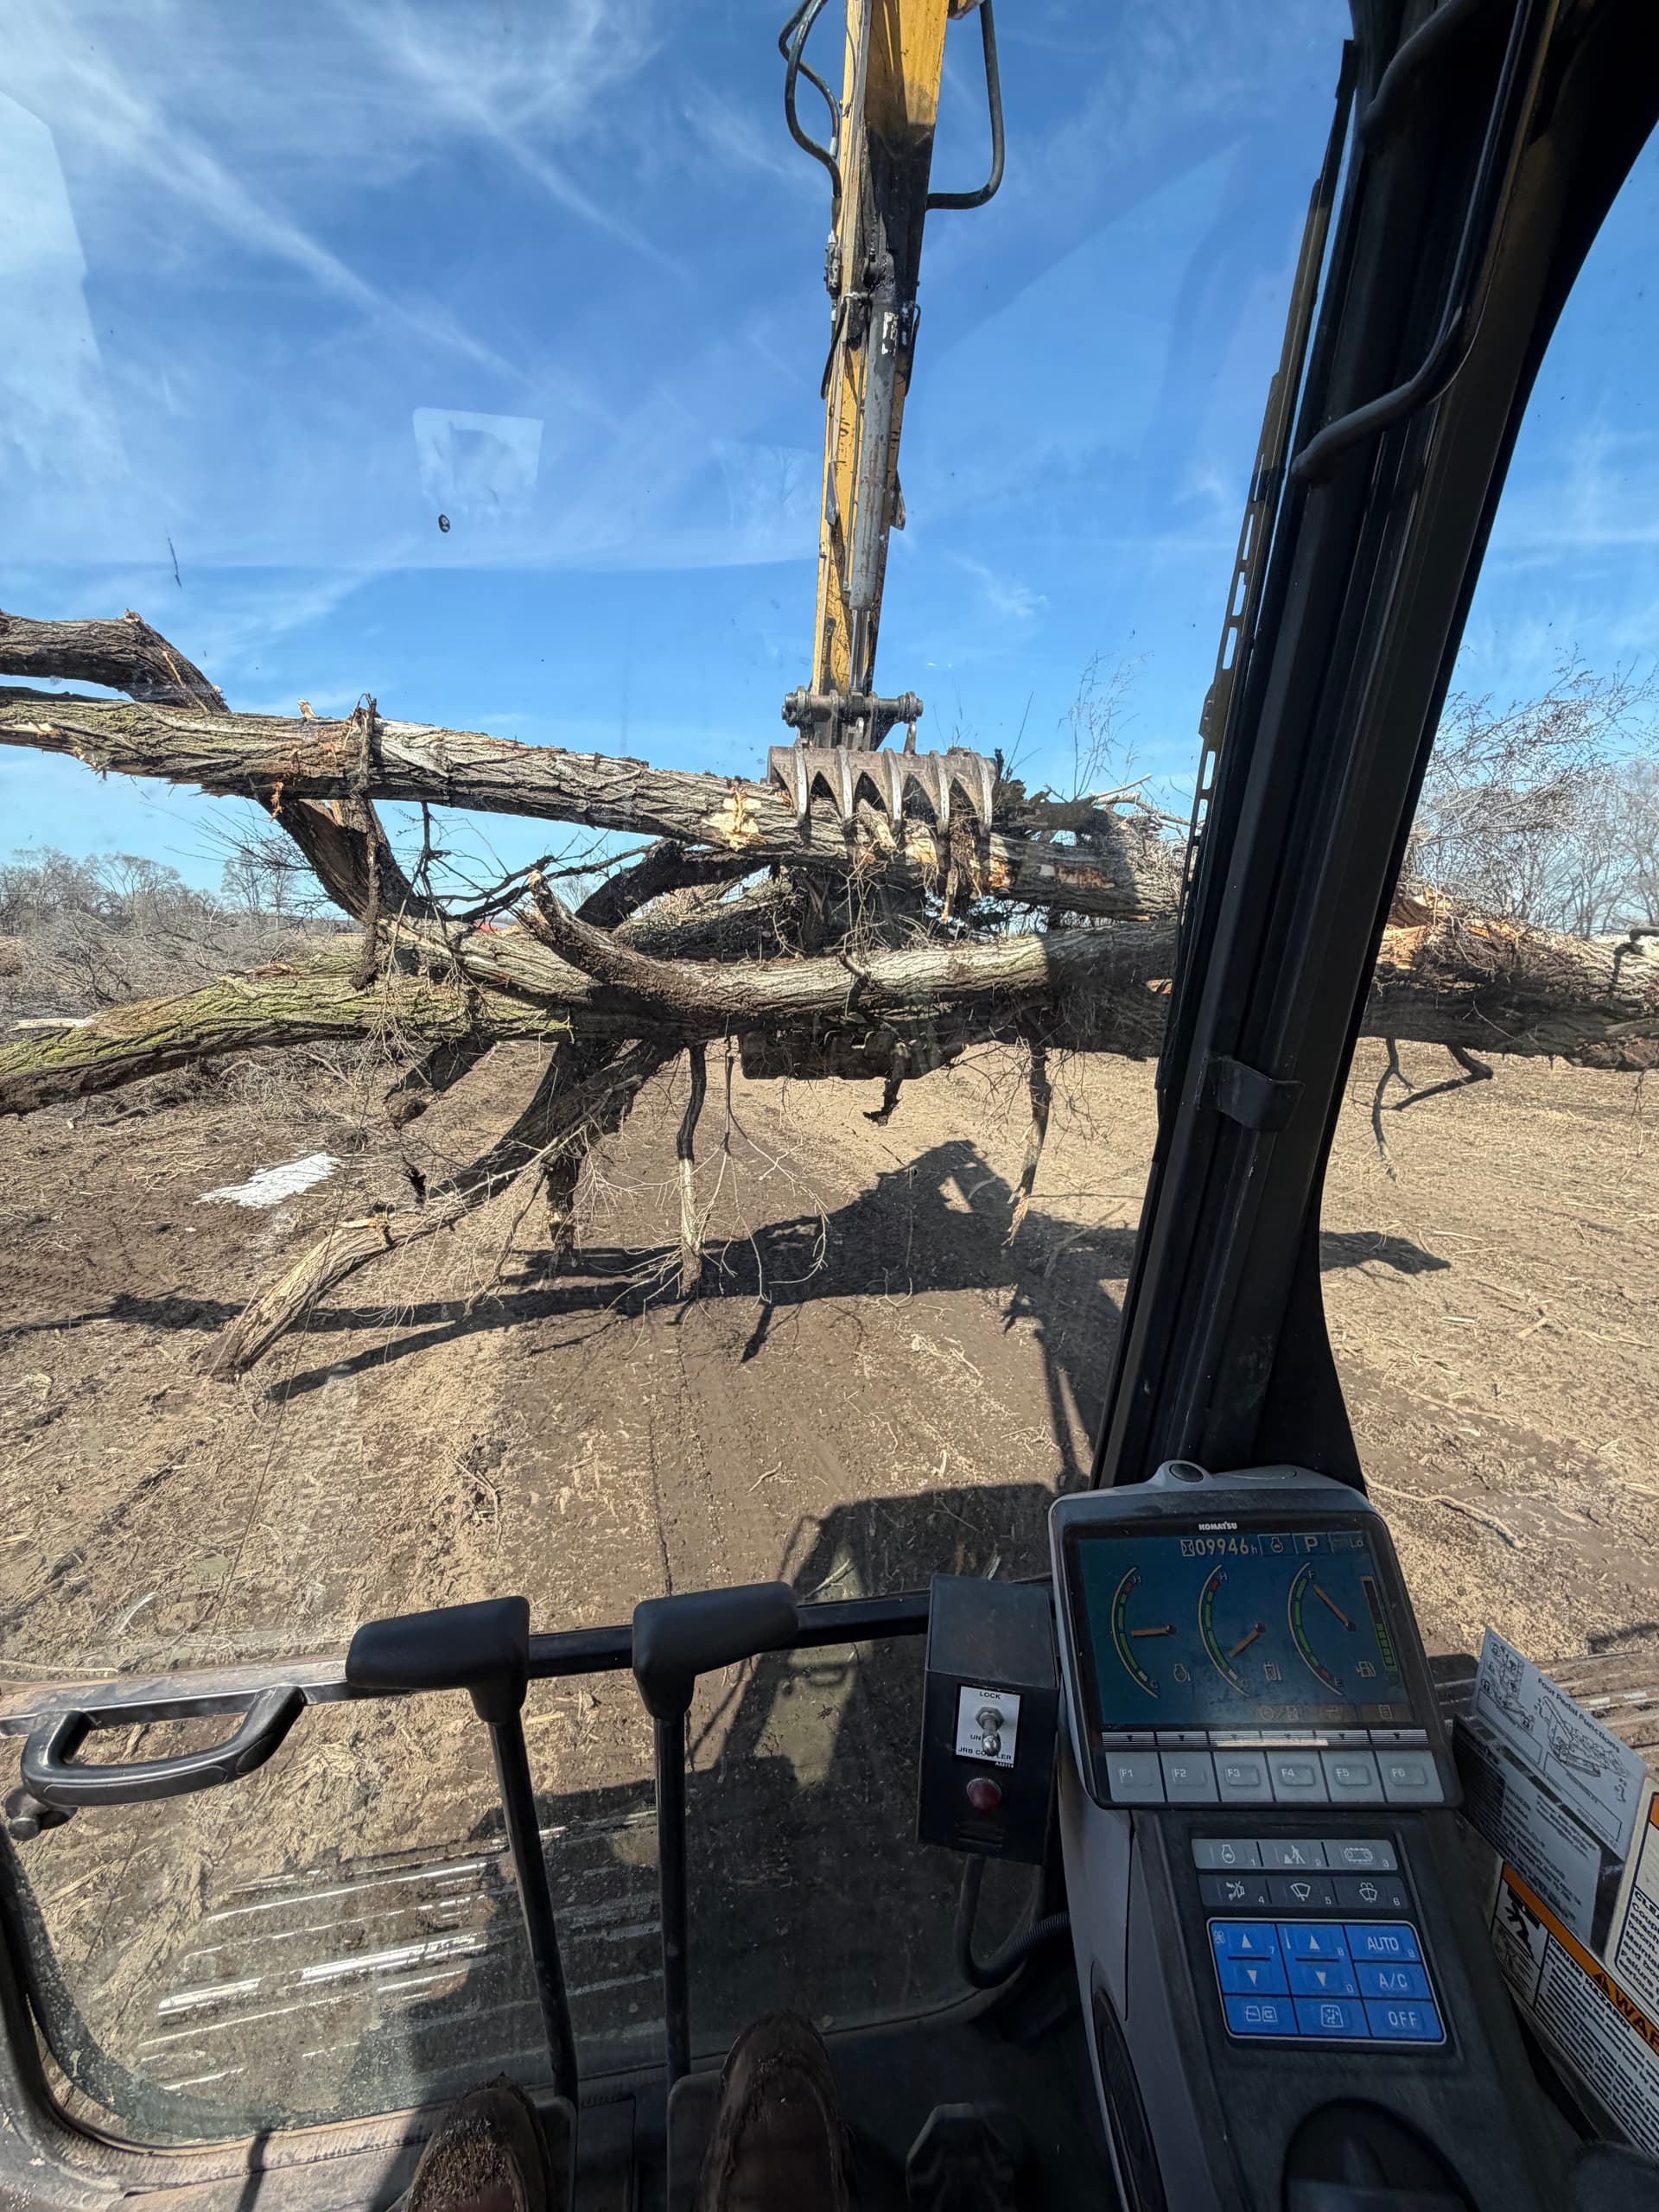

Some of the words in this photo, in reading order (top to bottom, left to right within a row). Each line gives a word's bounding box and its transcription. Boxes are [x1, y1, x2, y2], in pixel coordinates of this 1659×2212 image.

[1198, 1522, 1237, 1530] KOMATSU
[1305, 1536, 1318, 1552] P
[1219, 1573, 1228, 1581] H
[980, 1691, 1001, 1700] LOCK
[1538, 1678, 1554, 1696] Foot
[1555, 1694, 1579, 1717] Pedal
[1579, 1713, 1621, 1753] Functions
[976, 1749, 1012, 1760] COLER
[1122, 1769, 1133, 1777] F1
[1174, 1769, 1187, 1777] F2
[1228, 1769, 1241, 1777] F3
[1281, 1769, 1294, 1777] F4
[1337, 1769, 1350, 1777] F5
[1258, 1896, 1265, 1904] 4
[1325, 1896, 1332, 1904] 5
[1393, 1897, 1400, 1906] 6
[1367, 1936, 1399, 1950] AUTO
[1269, 1946, 1275, 1955] 7
[1624, 1940, 1641, 1961] and
[1550, 1937, 1583, 1978] CRUSH
[1621, 1949, 1654, 1987] Failure
[1378, 1973, 1408, 1988] A/C
[1618, 1959, 1654, 1999] serious
[1388, 2012, 1416, 2026] OFF
